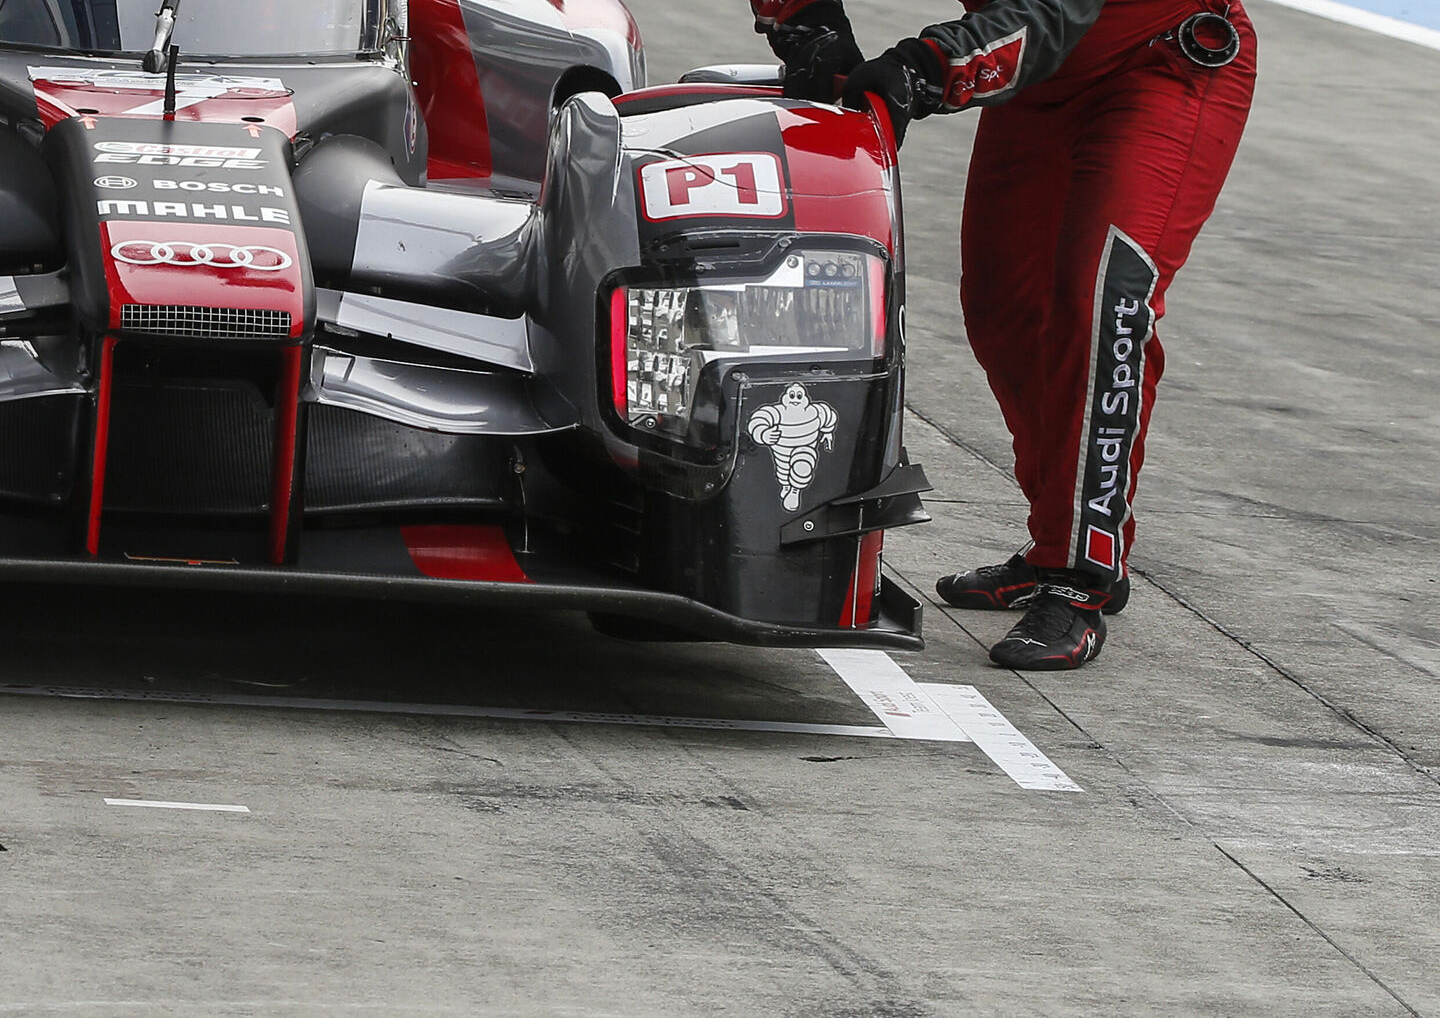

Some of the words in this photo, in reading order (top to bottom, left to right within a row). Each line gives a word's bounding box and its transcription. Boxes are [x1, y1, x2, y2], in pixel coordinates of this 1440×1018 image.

[93, 152, 270, 170] EDGE
[135, 143, 249, 159] Castrol
[152, 178, 286, 198] BOSCH
[665, 162, 759, 206] P1
[96, 199, 291, 225] MAHLE
[1100, 296, 1140, 416] Sport
[1087, 426, 1127, 518] Audi
